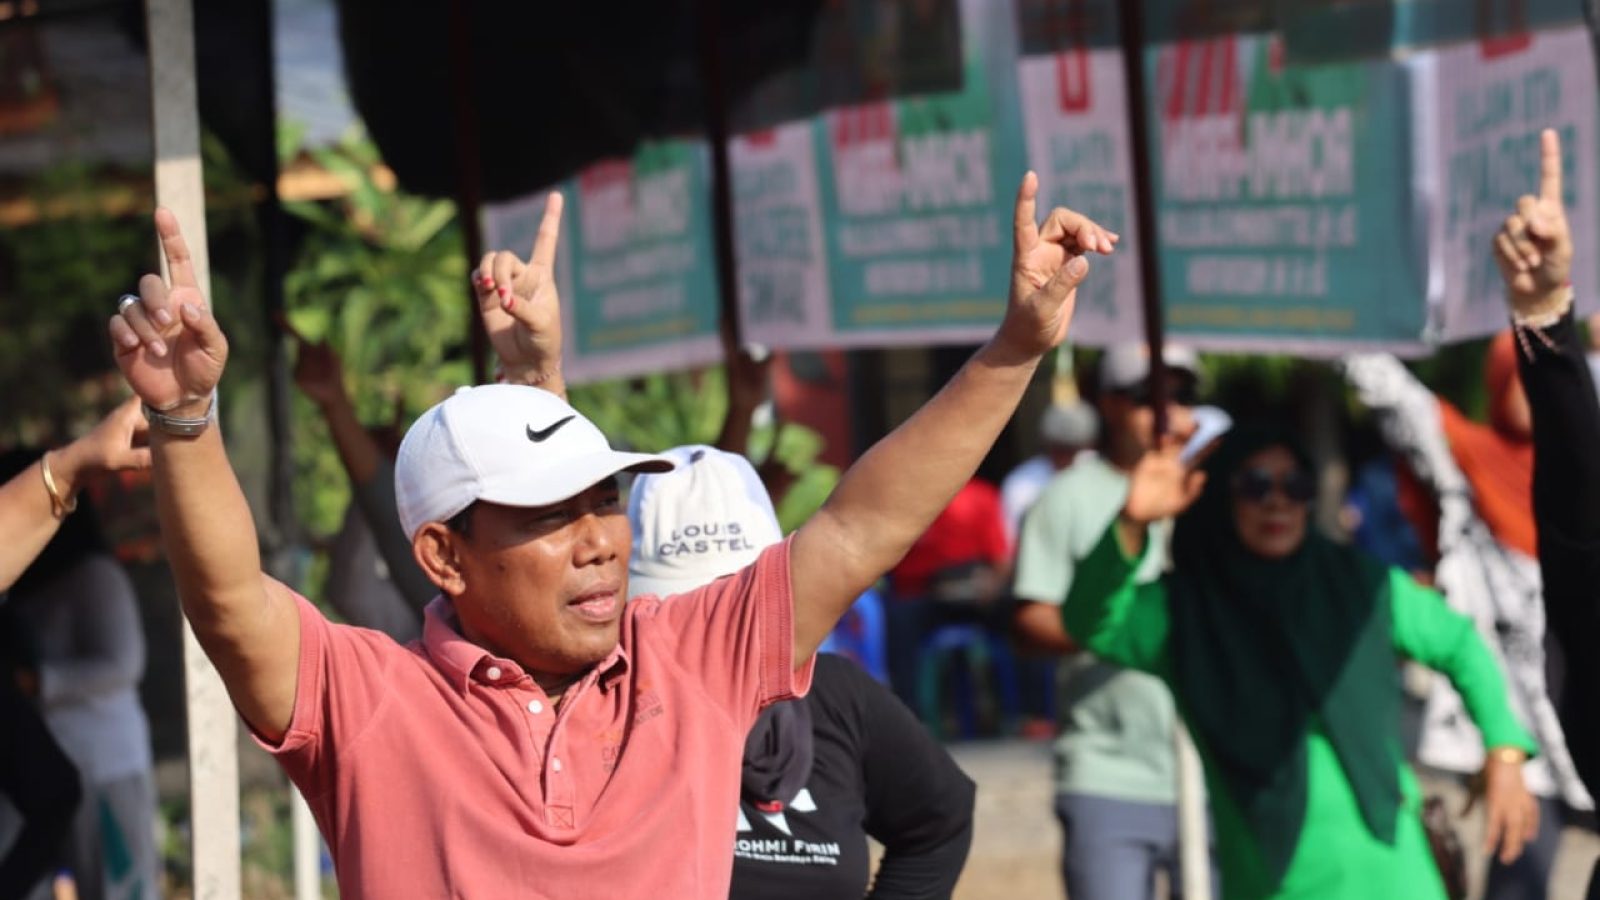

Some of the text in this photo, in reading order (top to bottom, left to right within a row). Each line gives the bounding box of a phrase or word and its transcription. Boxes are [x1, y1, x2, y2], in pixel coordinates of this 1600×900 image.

[671, 522, 741, 541] LOUIS
[659, 538, 754, 556] CASTEL
[734, 839, 787, 853] OHMI
